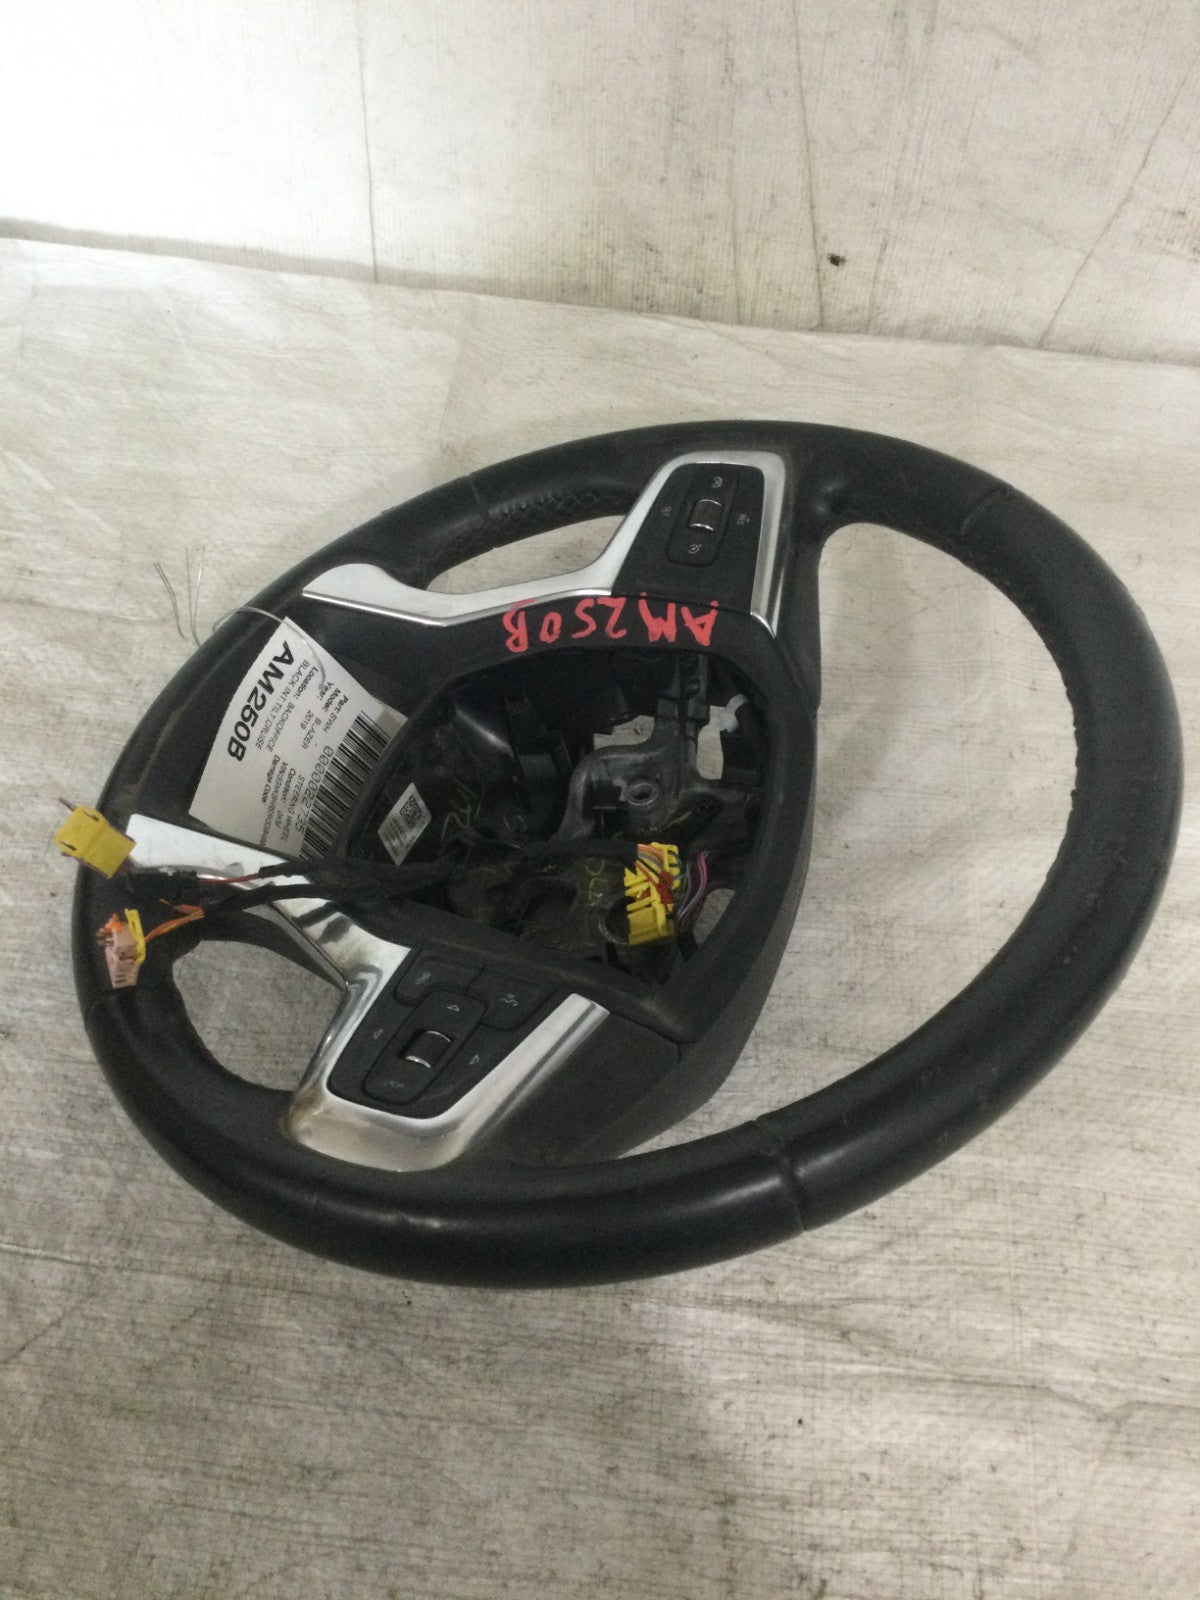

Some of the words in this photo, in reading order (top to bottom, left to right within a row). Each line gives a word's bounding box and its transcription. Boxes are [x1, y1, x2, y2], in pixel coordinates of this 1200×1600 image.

[289, 659, 310, 688] BLACK
[293, 666, 319, 700] Location:
[227, 640, 294, 761] AM250B
[322, 688, 341, 712] Model:
[266, 702, 295, 752] BACKOFFICE
[300, 710, 314, 730] 2019
[323, 712, 338, 733] SWH
